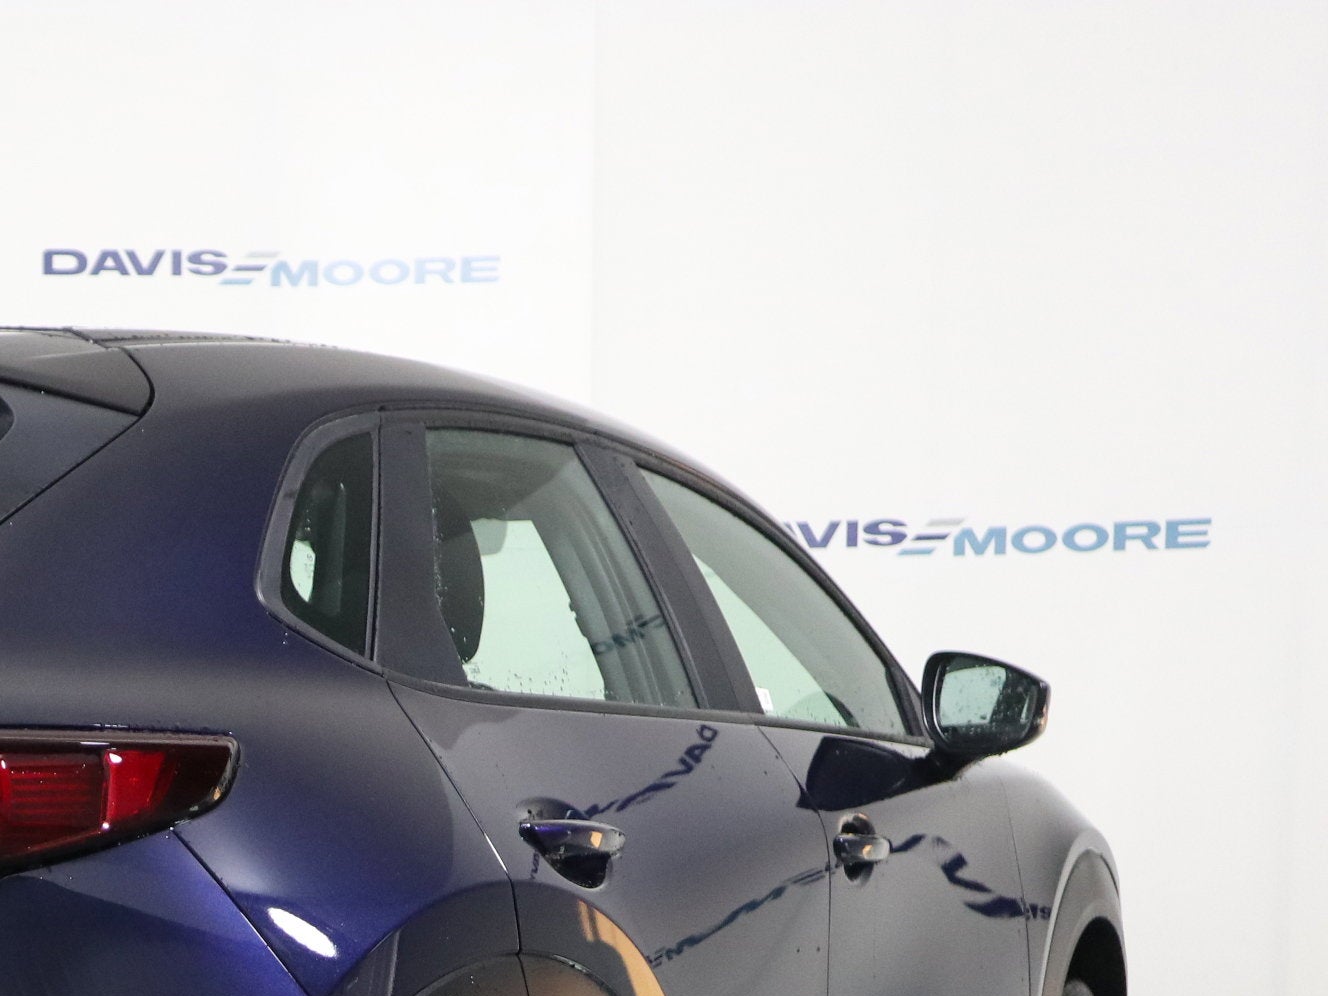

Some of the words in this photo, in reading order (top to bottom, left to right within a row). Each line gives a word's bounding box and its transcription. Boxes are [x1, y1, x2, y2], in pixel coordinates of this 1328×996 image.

[42, 248, 228, 277] DAVIS
[270, 255, 502, 288] MOORE
[784, 518, 908, 548] VIS
[952, 517, 1213, 557] MOORE
